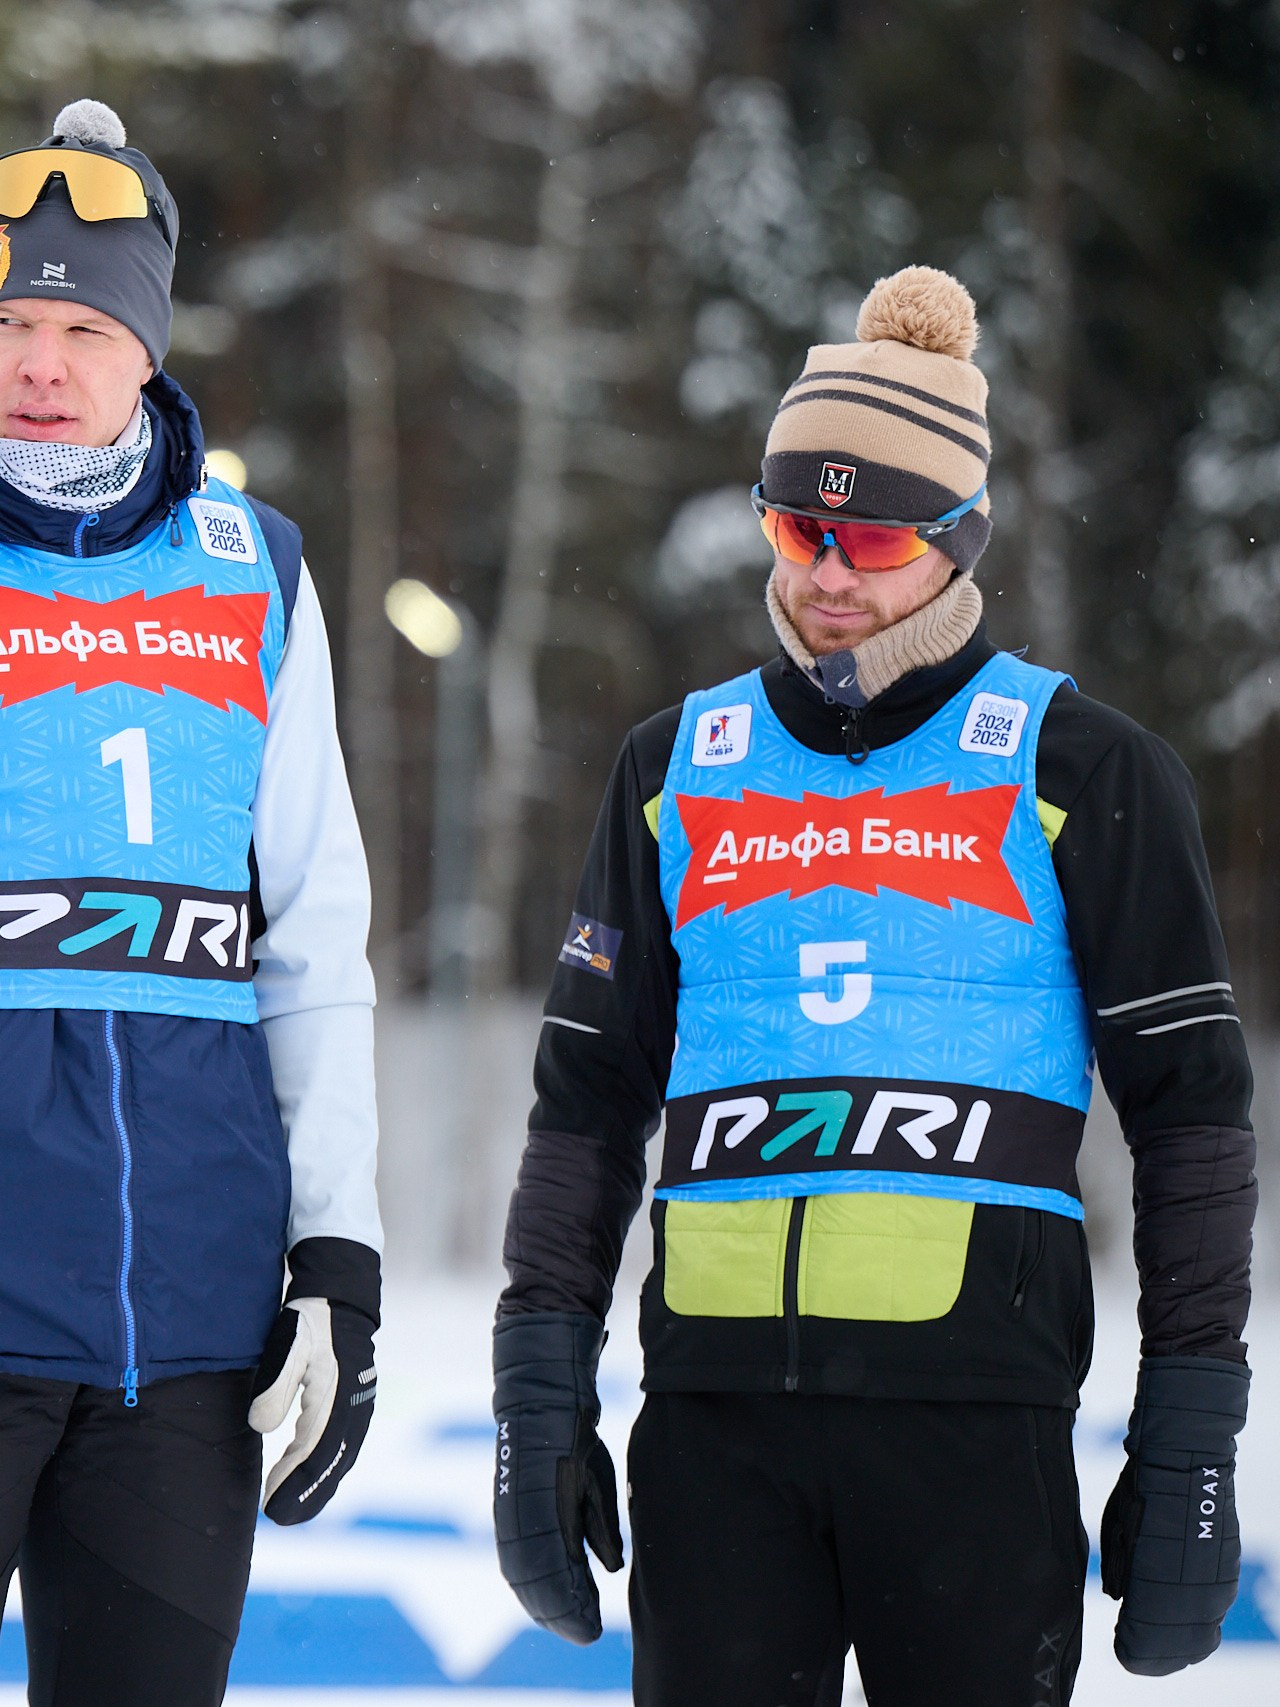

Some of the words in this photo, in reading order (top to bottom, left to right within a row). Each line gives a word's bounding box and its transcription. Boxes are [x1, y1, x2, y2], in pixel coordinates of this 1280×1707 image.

[30, 279, 76, 289] NORDSKI
[200, 504, 238, 521] СЕЗОН
[204, 516, 242, 537] 2024
[208, 532, 247, 554] 2025
[135, 620, 249, 666] Банк
[975, 712, 1014, 732] 2024
[980, 700, 1019, 720] СЕЗОН
[705, 747, 733, 756] СБР
[970, 729, 1010, 747] 2025
[100, 727, 154, 845] 1
[706, 821, 850, 869] Альфа
[861, 818, 982, 863] Банк
[798, 940, 873, 1026] 5
[690, 1089, 992, 1171] PARI
[499, 1421, 511, 1496] MOAX
[1198, 1467, 1220, 1539] MOAX
[1032, 1632, 1062, 1707] AX
